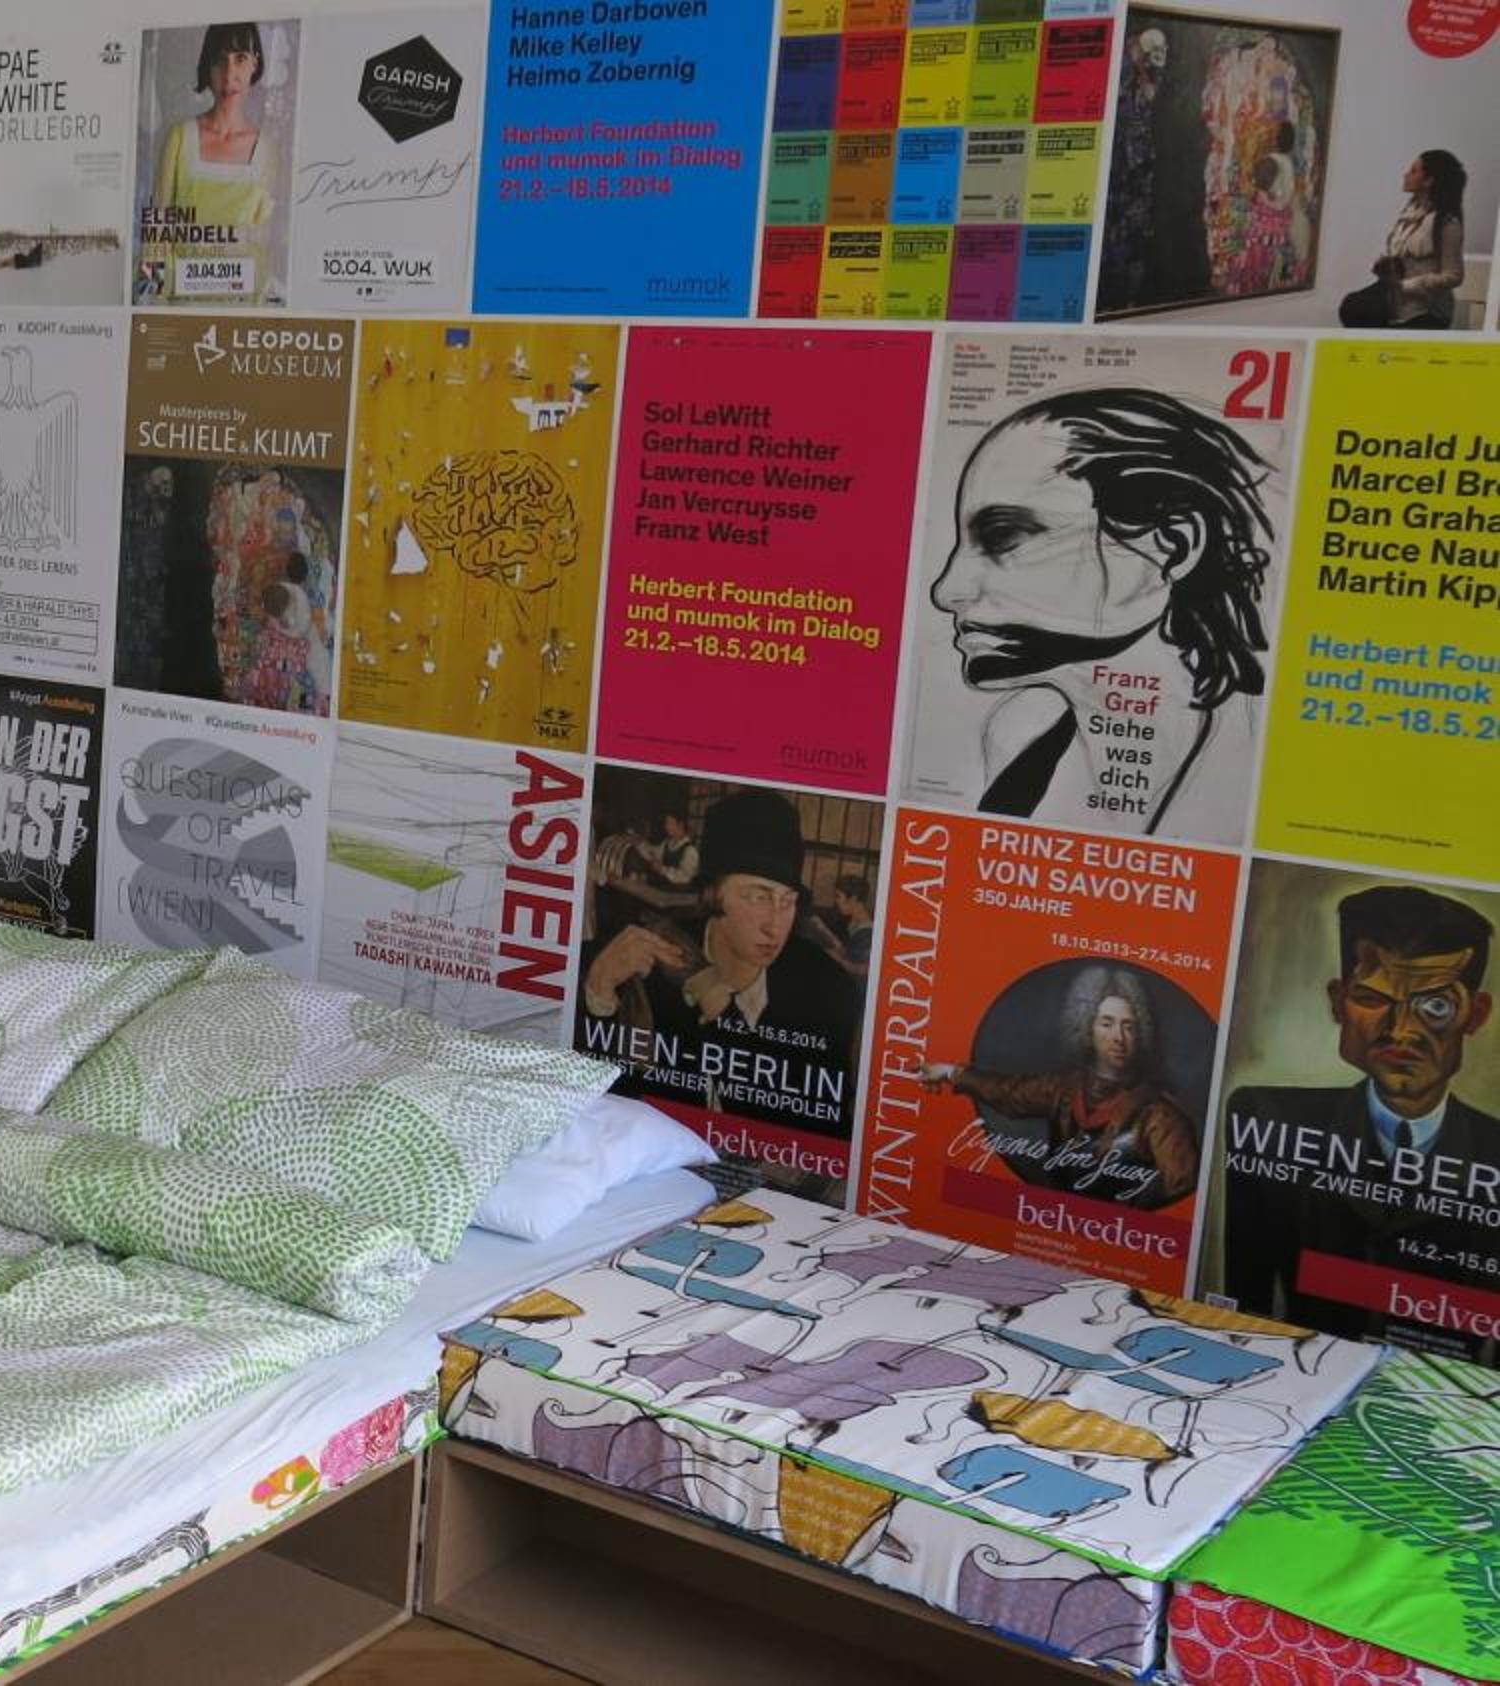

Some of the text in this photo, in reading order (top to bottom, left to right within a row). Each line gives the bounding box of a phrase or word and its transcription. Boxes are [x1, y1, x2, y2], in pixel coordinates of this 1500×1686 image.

[511, 0, 708, 30] Hanne Darboven
[509, 33, 642, 59] Mike Kelley
[373, 65, 451, 93] GARISH
[507, 56, 697, 88] Heimo Zobernig
[503, 119, 718, 146] Herbert Foundation
[502, 144, 742, 171] und mumok im Dialog
[141, 206, 197, 224] ELENI
[140, 224, 239, 244] MANDELL
[186, 262, 242, 279] 20.04.2014
[323, 259, 433, 277] 10.04. WUK
[647, 273, 731, 297] mumok
[232, 329, 344, 351] LEOPOLD
[230, 353, 342, 378] MUSEUM
[159, 404, 247, 424] Masterpieces by
[643, 401, 772, 428] Sol LeWitt
[138, 421, 237, 452] SCHIELE
[253, 427, 333, 459] KLIMT
[642, 430, 840, 461] Gerhard Richter
[1335, 429, 1458, 460] Donald
[639, 459, 854, 493] Lawrence Weiner
[1331, 463, 1500, 498] Marcel Br
[635, 489, 817, 522] Jan Vercruysse
[1326, 497, 1392, 526] Dan
[635, 516, 771, 547] Franz West
[1321, 531, 1421, 563] Bruce
[19, 558, 38, 571] DES
[41, 561, 79, 576] LEBENS
[629, 573, 853, 614] Herbert Foundation
[1317, 565, 1500, 610] Martin Kip
[627, 602, 880, 649] und mumok im Dialog
[1308, 633, 1500, 674] Herbert Fou
[1092, 664, 1161, 691] Franz
[1305, 668, 1493, 704] und mumok
[1104, 691, 1158, 716] Graf
[1087, 714, 1156, 741] Siehe
[28, 719, 91, 779] DER
[780, 744, 868, 770] mumok
[1105, 745, 1153, 766] was
[119, 758, 303, 819] QUESTIONS
[1099, 768, 1150, 790] dich
[1086, 793, 1149, 816] sieht
[187, 812, 233, 848] OF
[980, 827, 1195, 881] PRINZ EUGEN
[188, 853, 305, 908] TRAVEL
[496, 750, 585, 1001] ASIEN
[977, 857, 1197, 913] VON SAVOYEN
[972, 887, 1074, 917] 350 JAHRE
[353, 941, 492, 984] TADASHI KAWAMATA
[867, 820, 950, 1225] WINTERPALAIS
[643, 1065, 841, 1122] ZWEIER METROPOLEN
[705, 1120, 846, 1179] belvedere
[1225, 1152, 1304, 1184] KUNST
[1311, 1170, 1404, 1206] ZWEIER
[1016, 1194, 1178, 1259] belvedere
